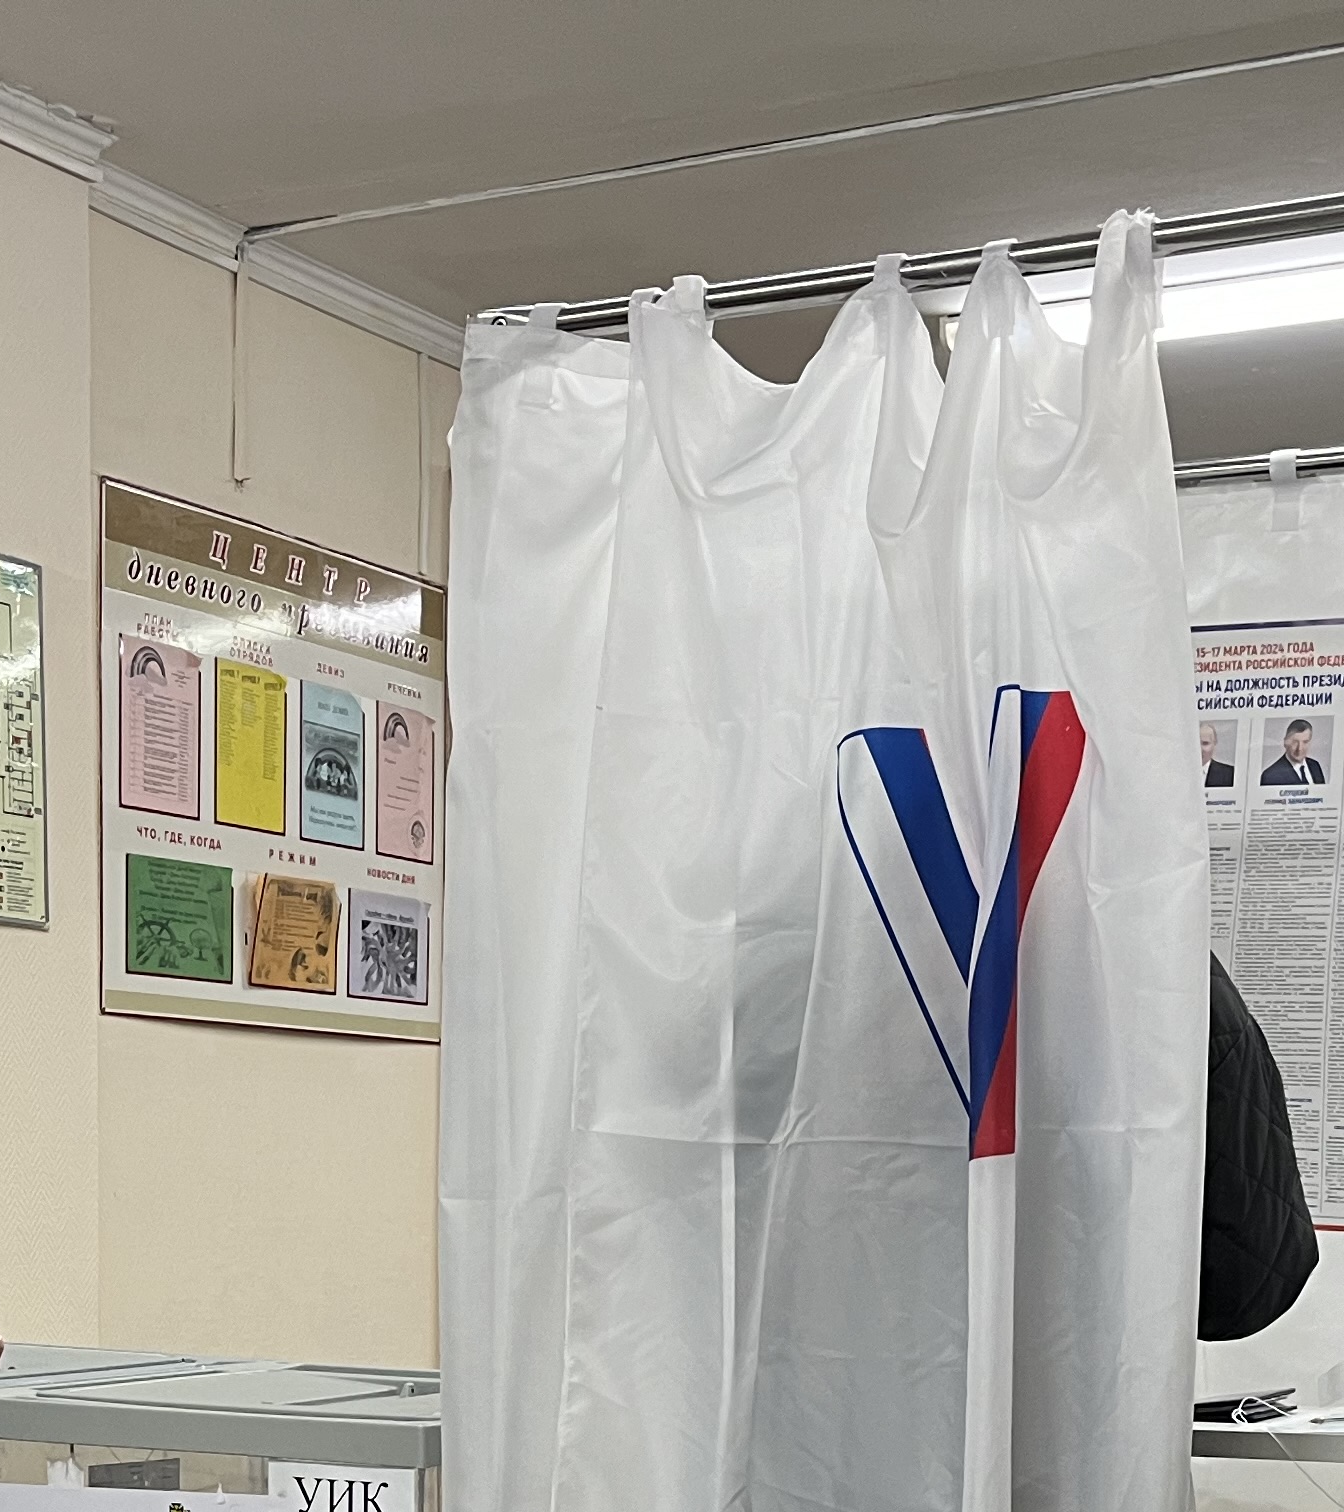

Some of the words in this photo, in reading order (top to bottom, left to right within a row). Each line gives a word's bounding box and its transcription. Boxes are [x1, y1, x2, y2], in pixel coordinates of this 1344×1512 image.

[210, 532, 371, 603] ЦЕНТР
[128, 549, 262, 613] дневного
[229, 646, 274, 668] ОТРЯДОВ
[1223, 644, 1258, 657] МАРТА
[1260, 643, 1285, 656] 2024
[1287, 641, 1315, 654] ГОДА
[1246, 653, 1315, 670] РОССИЙСКОЙ
[316, 662, 345, 679] ДЕВИЗ
[1207, 680, 1222, 693] НА
[1224, 676, 1299, 693] ДОЛЖНОСТЬ
[1197, 693, 1254, 710] СИЙСКОЙ
[1257, 692, 1333, 709] ФЕДЕРАЦИИ
[190, 834, 222, 851] КОГДА
[268, 848, 317, 867] РЕЖИМ
